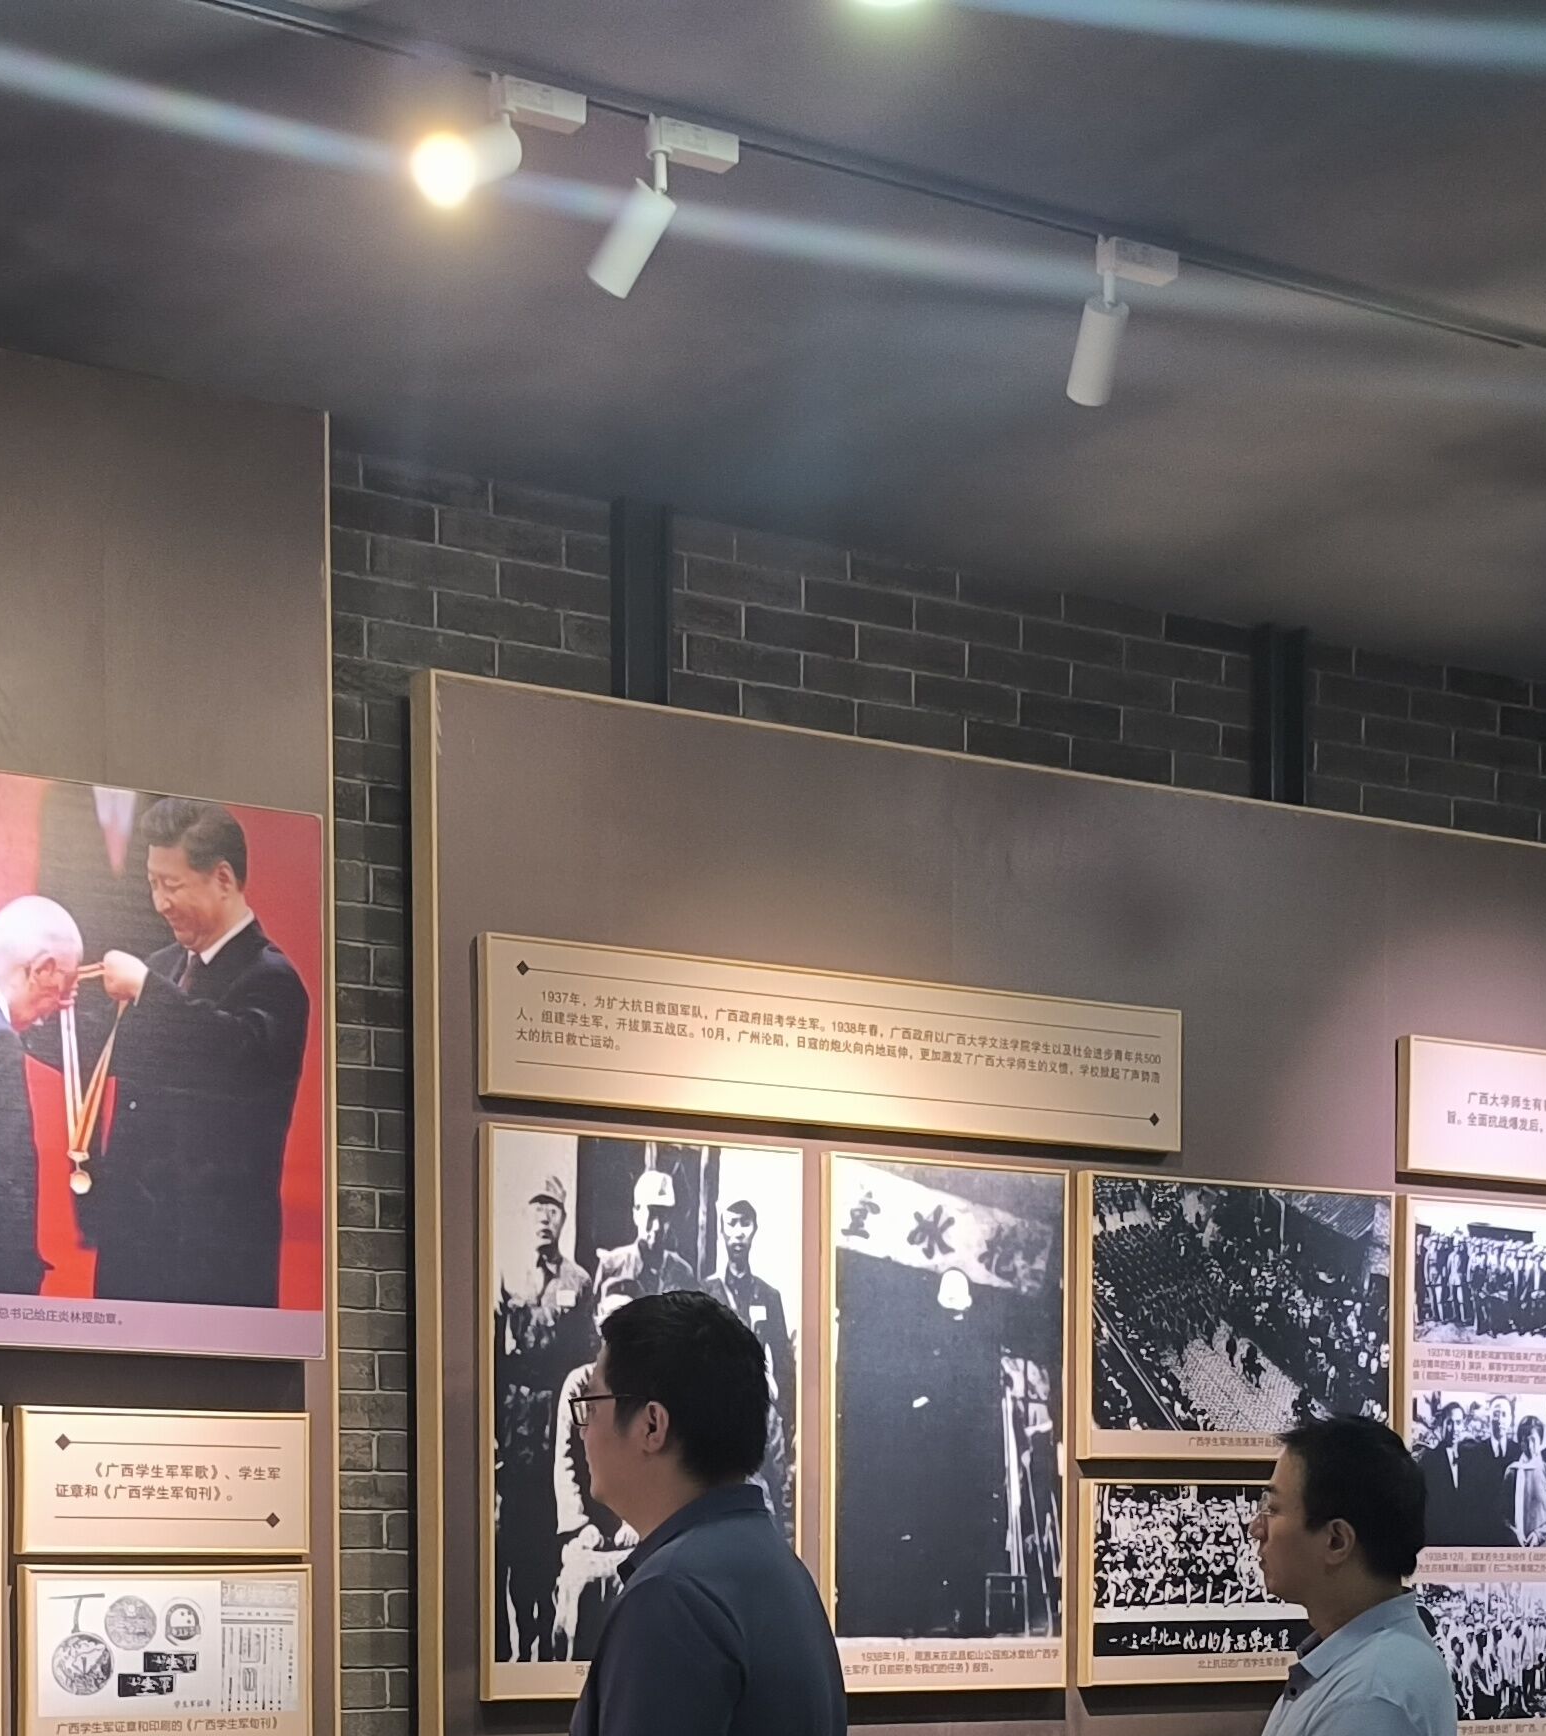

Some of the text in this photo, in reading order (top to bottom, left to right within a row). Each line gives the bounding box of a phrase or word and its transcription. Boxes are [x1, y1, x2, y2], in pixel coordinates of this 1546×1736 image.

[516, 1028, 621, 1051] 大的抗日救亡运动。
[94, 1462, 281, 1480] 《广西学生军军歌》、学生军
[55, 1483, 233, 1501] 证章和《广西学生军旬刊》。
